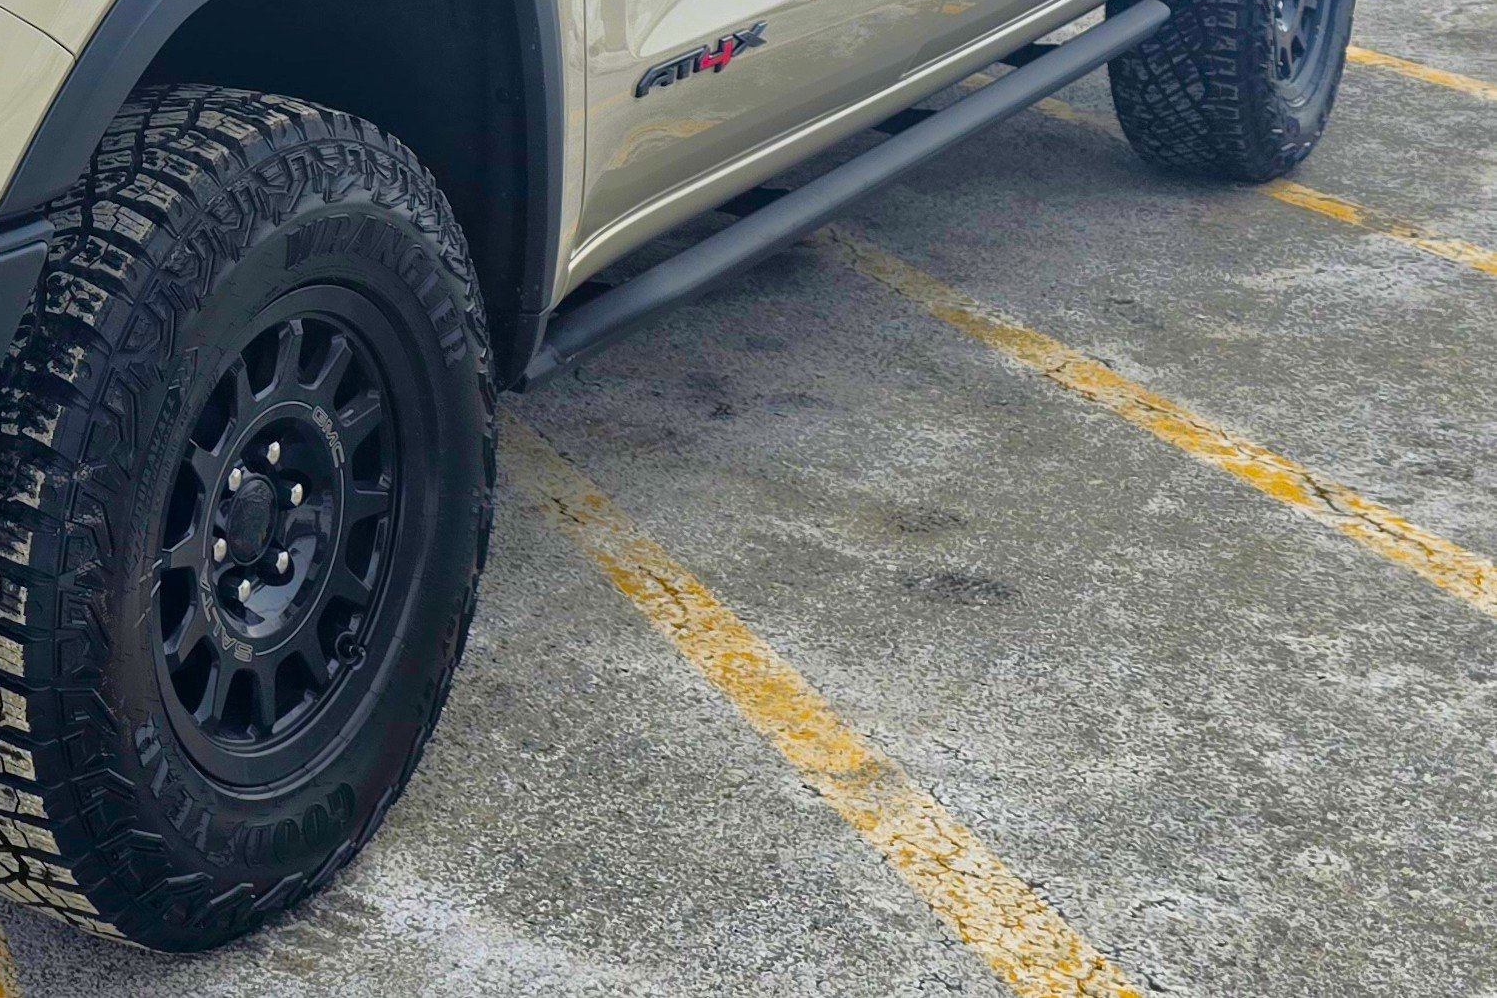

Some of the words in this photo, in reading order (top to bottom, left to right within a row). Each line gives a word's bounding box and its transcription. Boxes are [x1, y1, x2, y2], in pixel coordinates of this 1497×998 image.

[635, 20, 768, 98] AT4X
[285, 213, 468, 369] WRANGLER
[311, 404, 345, 469] GMC
[134, 711, 356, 869] GOODYEAR
